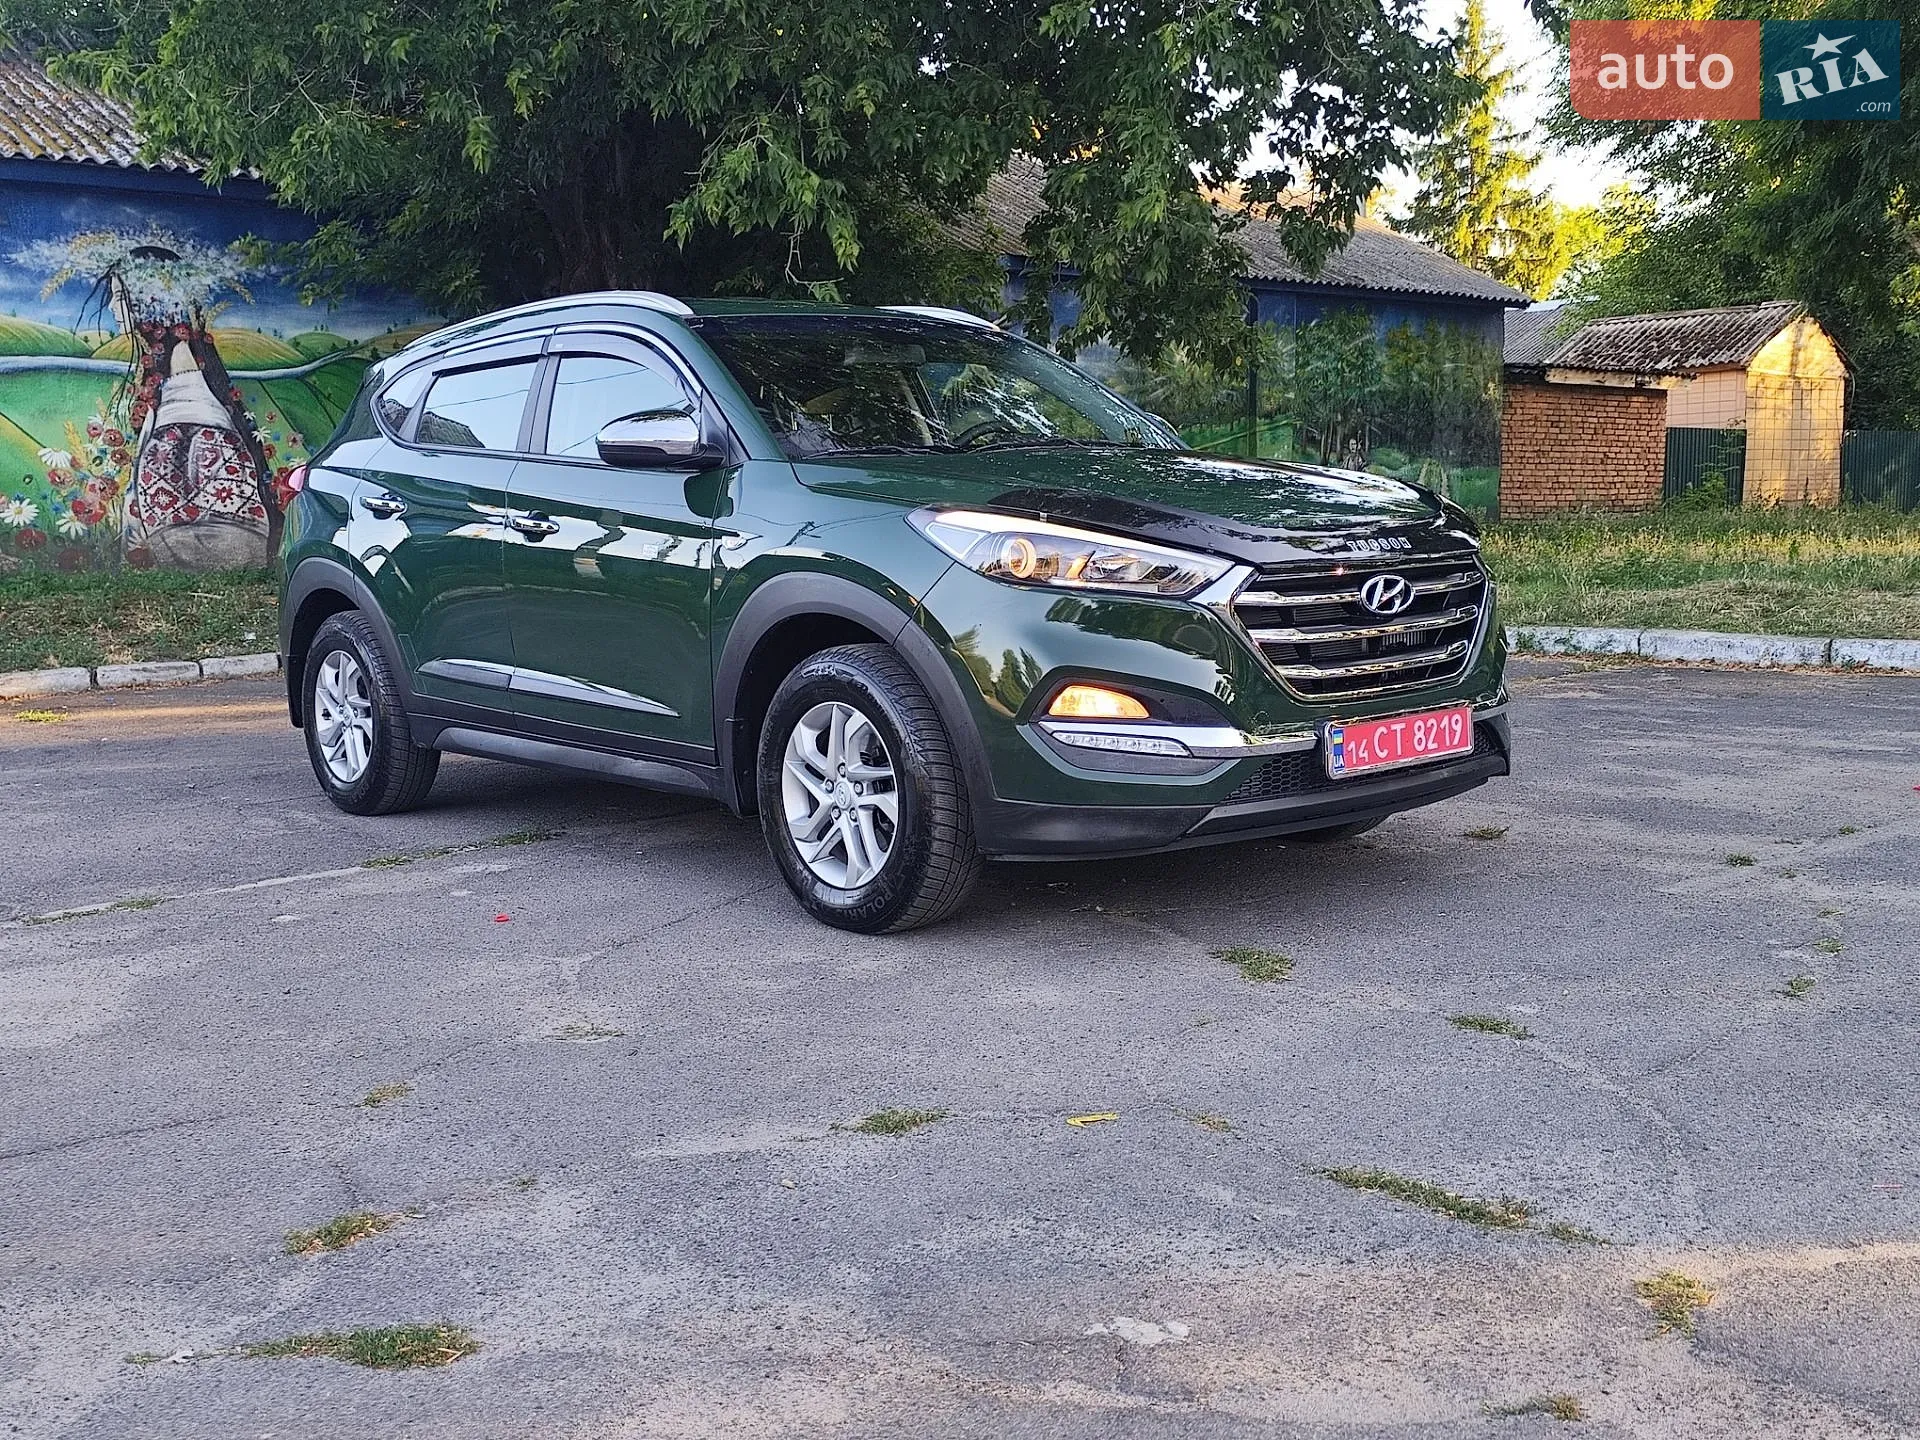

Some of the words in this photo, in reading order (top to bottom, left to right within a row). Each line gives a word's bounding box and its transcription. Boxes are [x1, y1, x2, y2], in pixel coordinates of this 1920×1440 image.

[1346, 537, 1412, 552] TUCSON
[1347, 739, 1369, 765] 14
[1373, 722, 1406, 758] CT
[1413, 713, 1463, 752] 8219
[1334, 755, 1345, 767] UA
